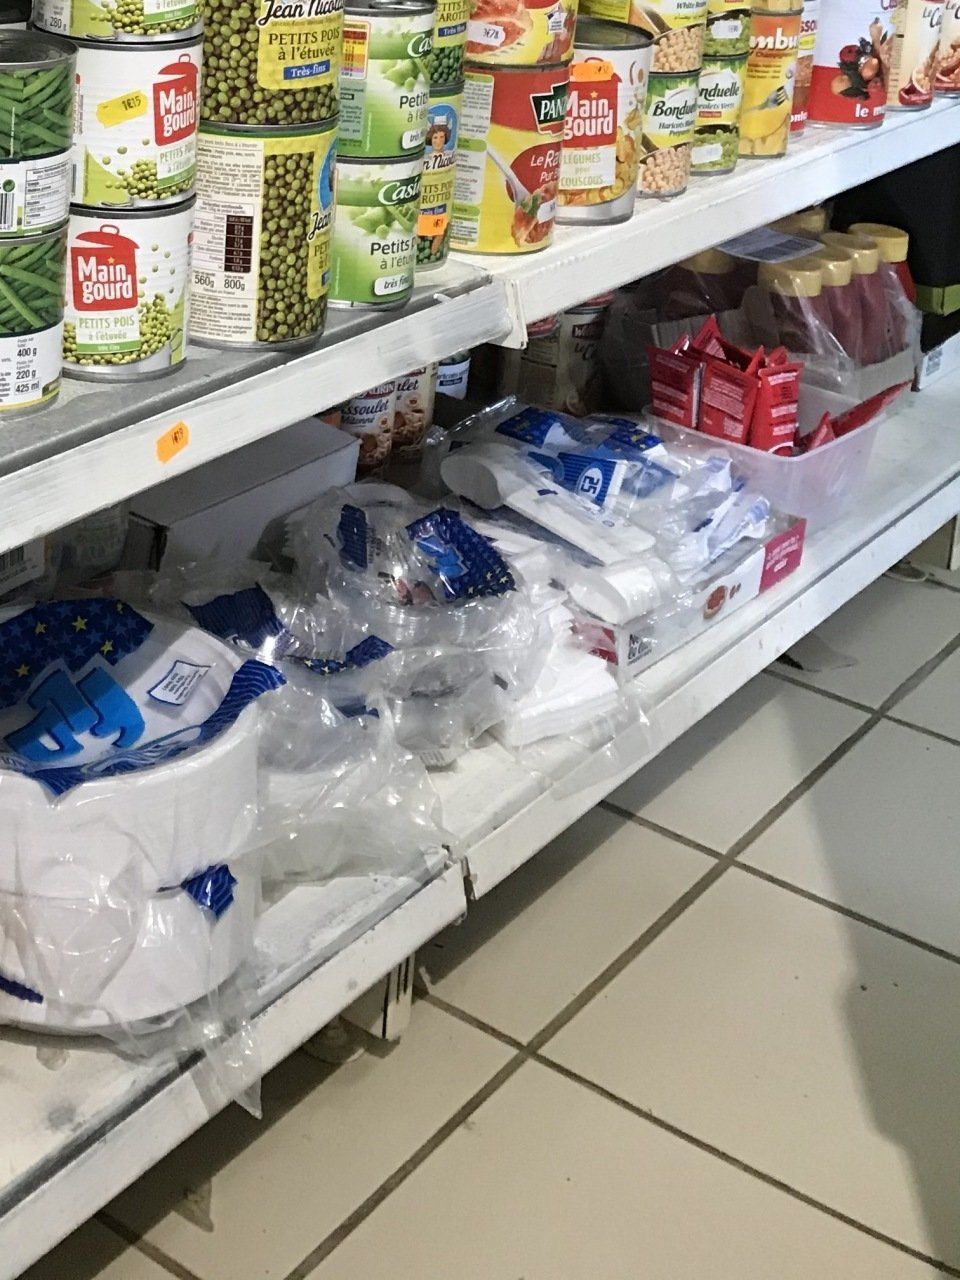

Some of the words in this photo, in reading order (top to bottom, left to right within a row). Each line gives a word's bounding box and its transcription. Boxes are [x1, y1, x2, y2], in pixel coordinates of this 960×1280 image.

[268, 31, 318, 47] PETITS
[320, 26, 341, 43] POIS
[407, 34, 433, 57] Cas
[277, 46, 286, 61] à
[290, 42, 335, 61] l'étuvée
[698, 82, 740, 101] nduelle
[159, 90, 194, 117] Main
[854, 103, 869, 118] le
[162, 104, 195, 138] gourd
[563, 109, 614, 140] gourd
[530, 154, 544, 167] Le
[370, 239, 410, 256] Petits
[77, 256, 127, 283] Main
[82, 274, 133, 305] gourd
[194, 273, 215, 289] 560g
[223, 278, 246, 292] 800g
[79, 317, 110, 329] PETITS
[114, 316, 136, 327] POIS
[16, 347, 30, 358] 400
[16, 370, 30, 380] 220
[15, 383, 30, 393] 425
[581, 474, 603, 498] 25
